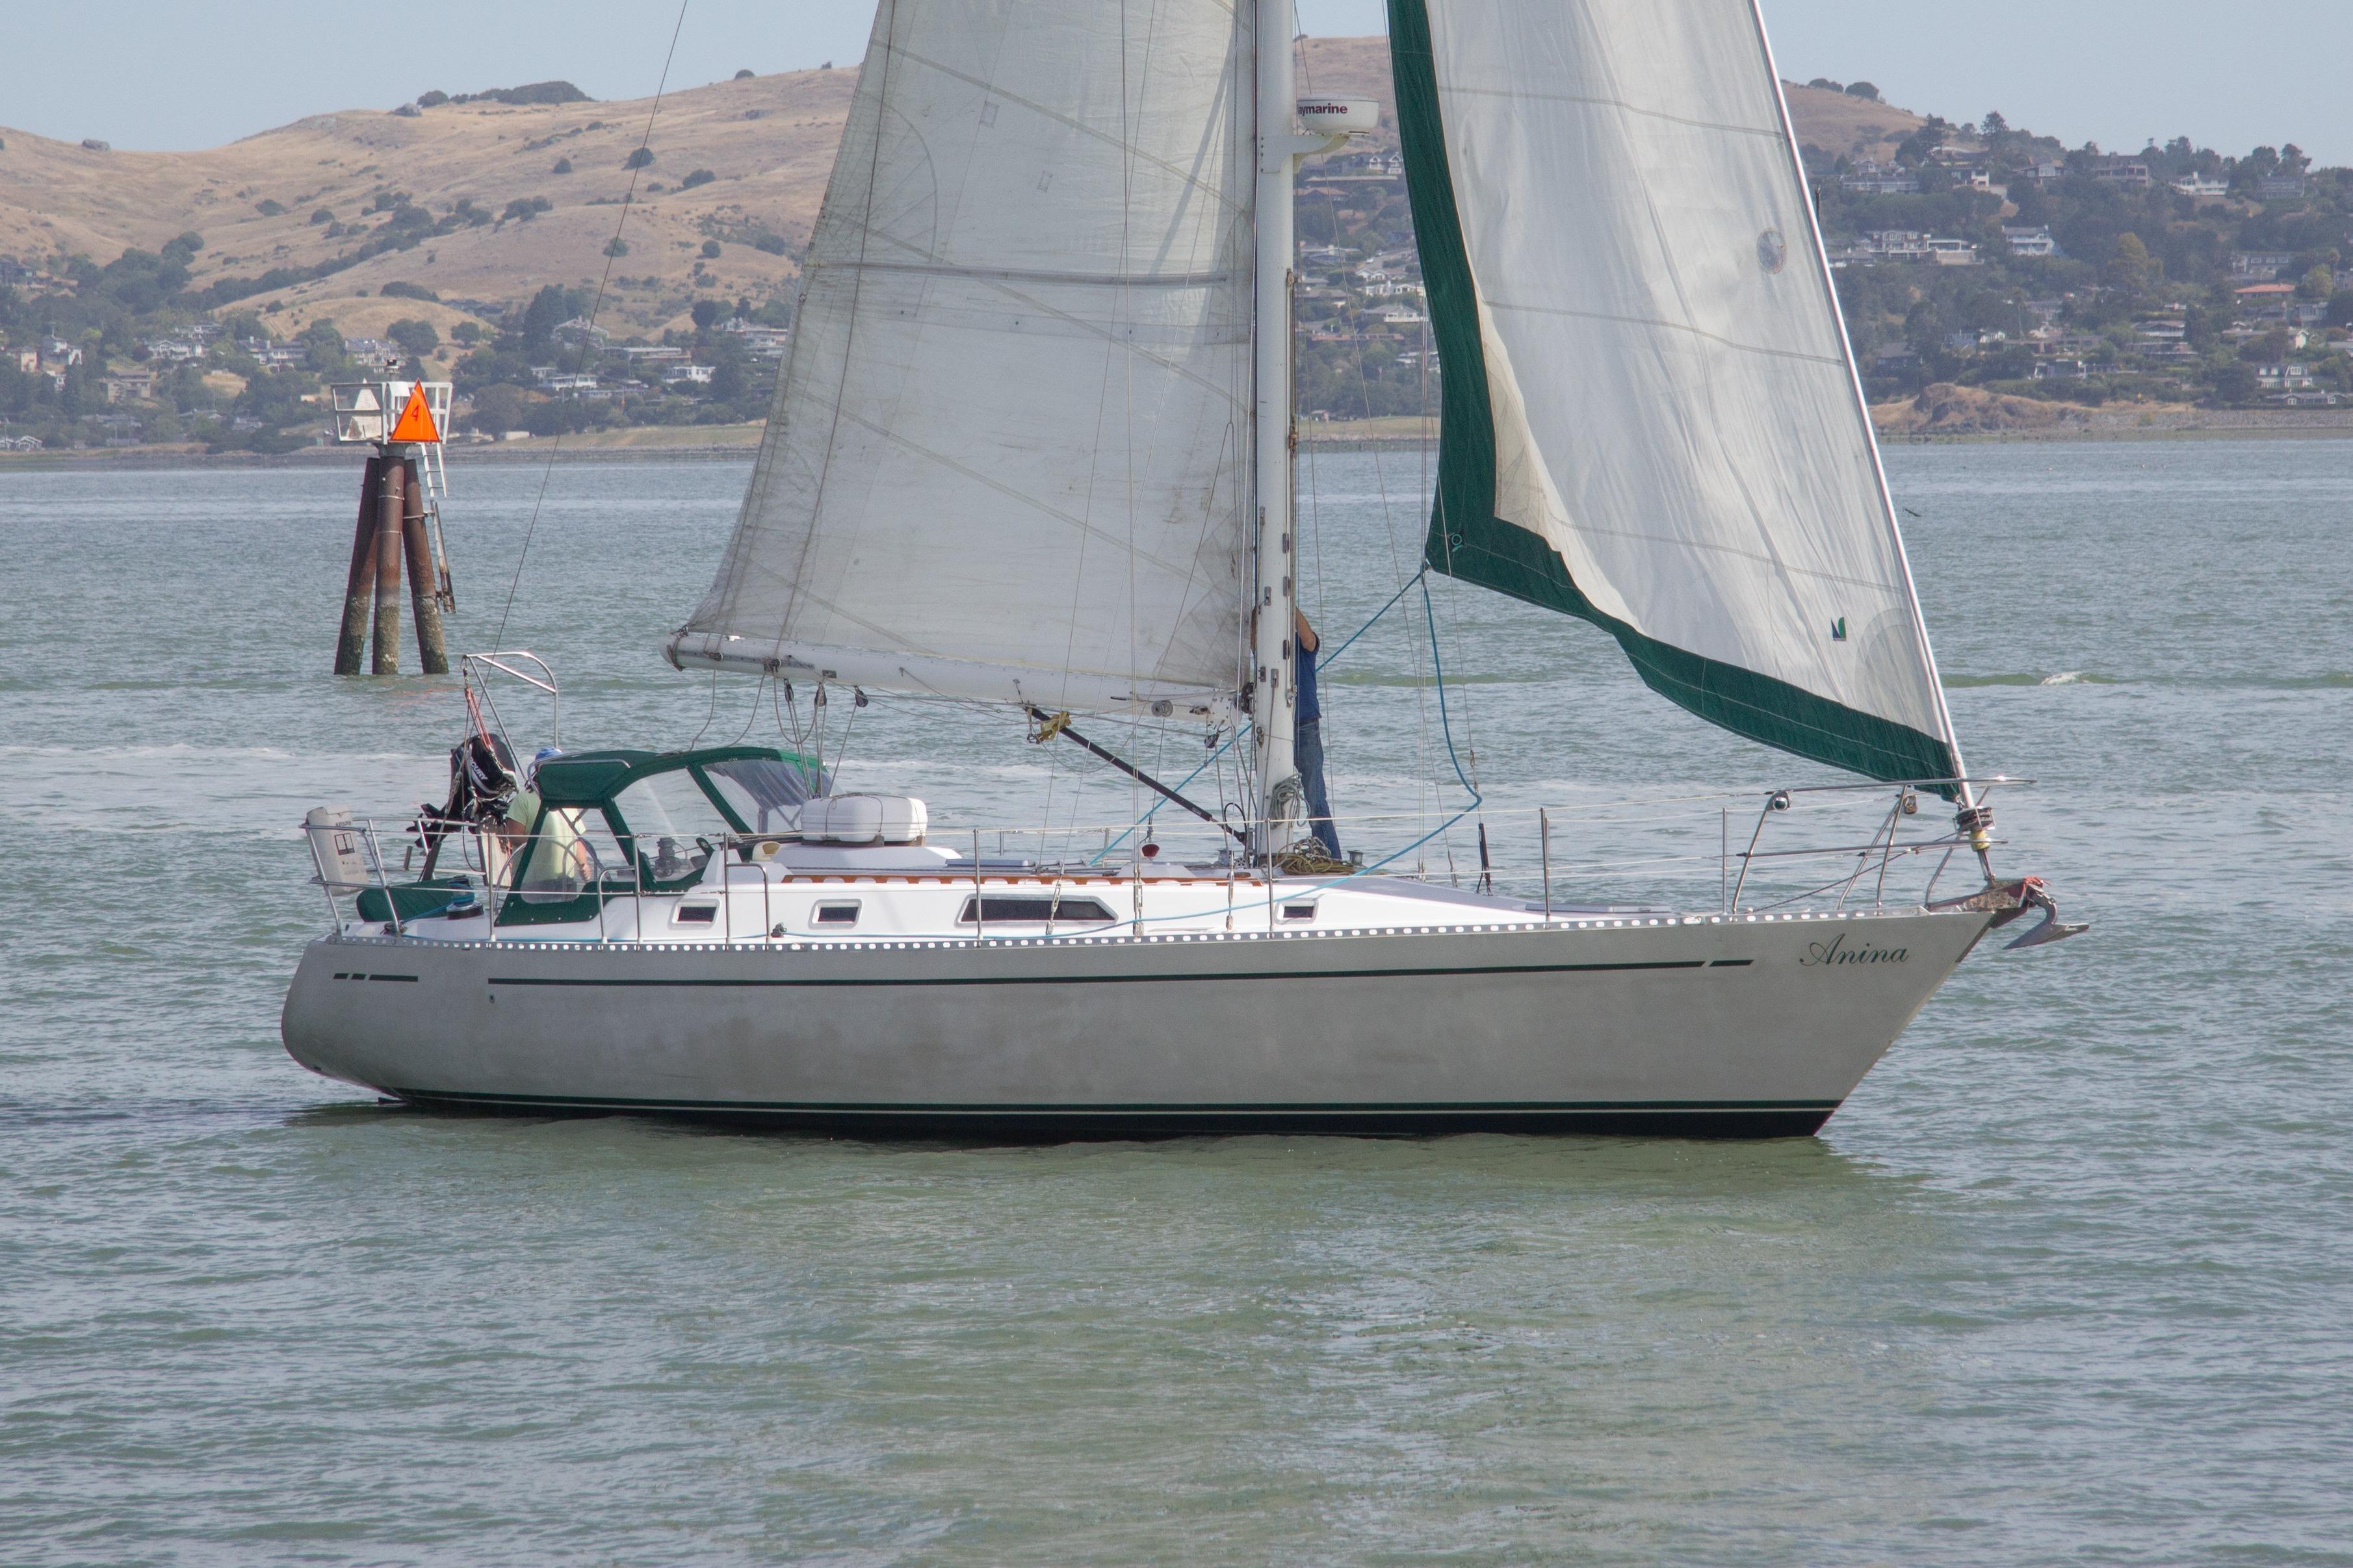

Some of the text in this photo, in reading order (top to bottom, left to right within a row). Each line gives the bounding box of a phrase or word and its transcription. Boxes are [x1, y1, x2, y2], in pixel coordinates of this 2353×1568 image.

[1298, 103, 1348, 116] aymarine
[411, 405, 419, 422] 4
[469, 757, 489, 780] CURY
[1799, 933, 1910, 966] Anina
